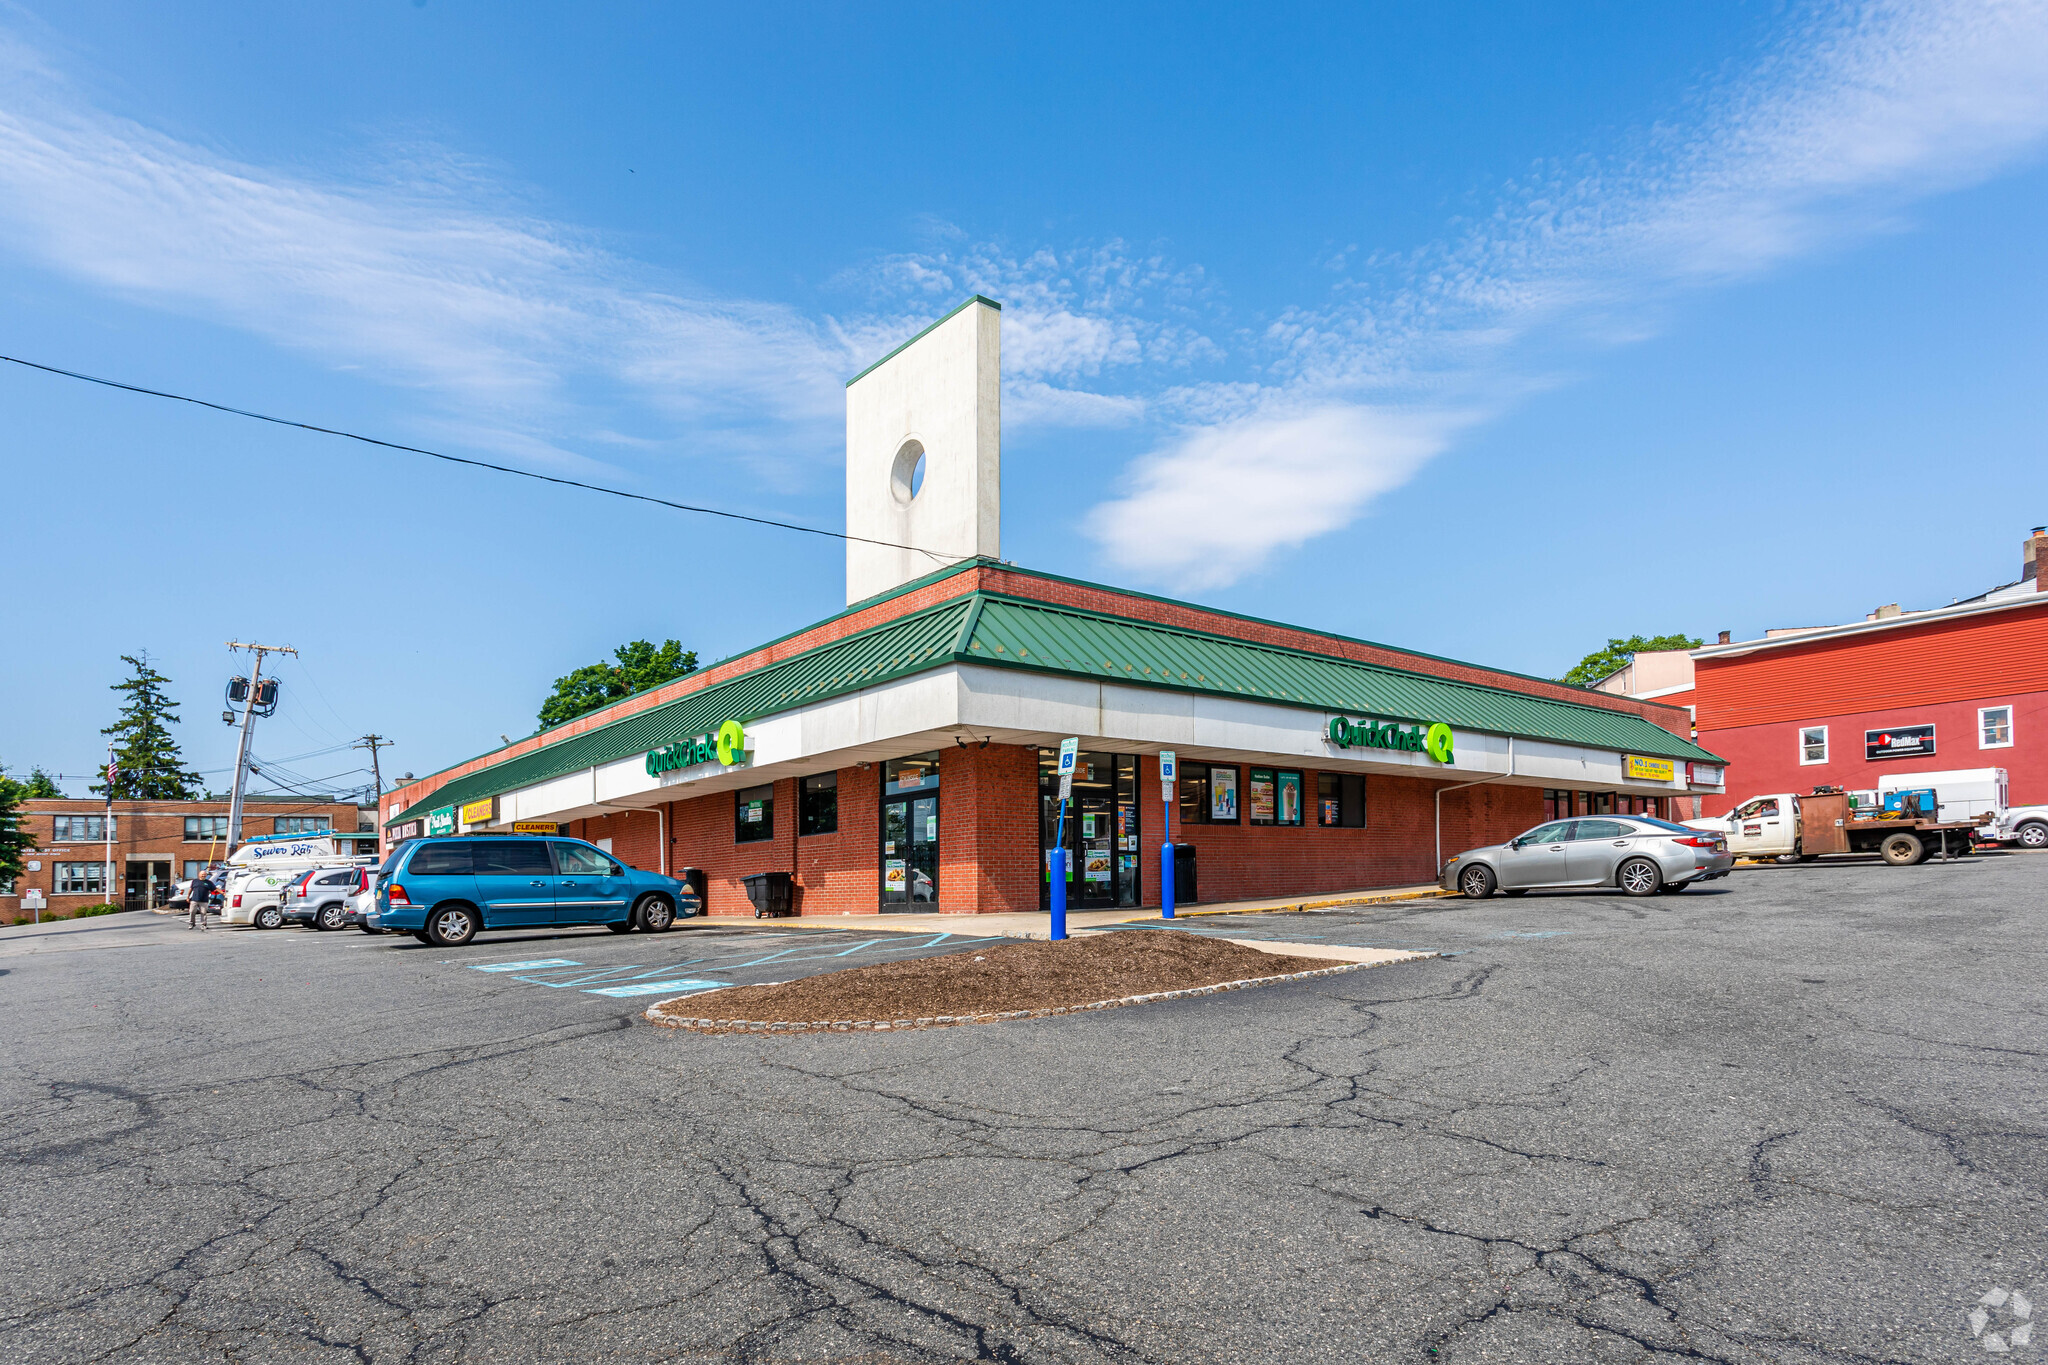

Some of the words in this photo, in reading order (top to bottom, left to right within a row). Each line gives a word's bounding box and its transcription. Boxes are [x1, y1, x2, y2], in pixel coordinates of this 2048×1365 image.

[1330, 716, 1427, 752] QuickChek
[1891, 736, 1920, 748] RedMax
[646, 733, 715, 778] QuickChek
[467, 802, 492, 820] CLEANERS
[253, 846, 288, 859] Sewer
